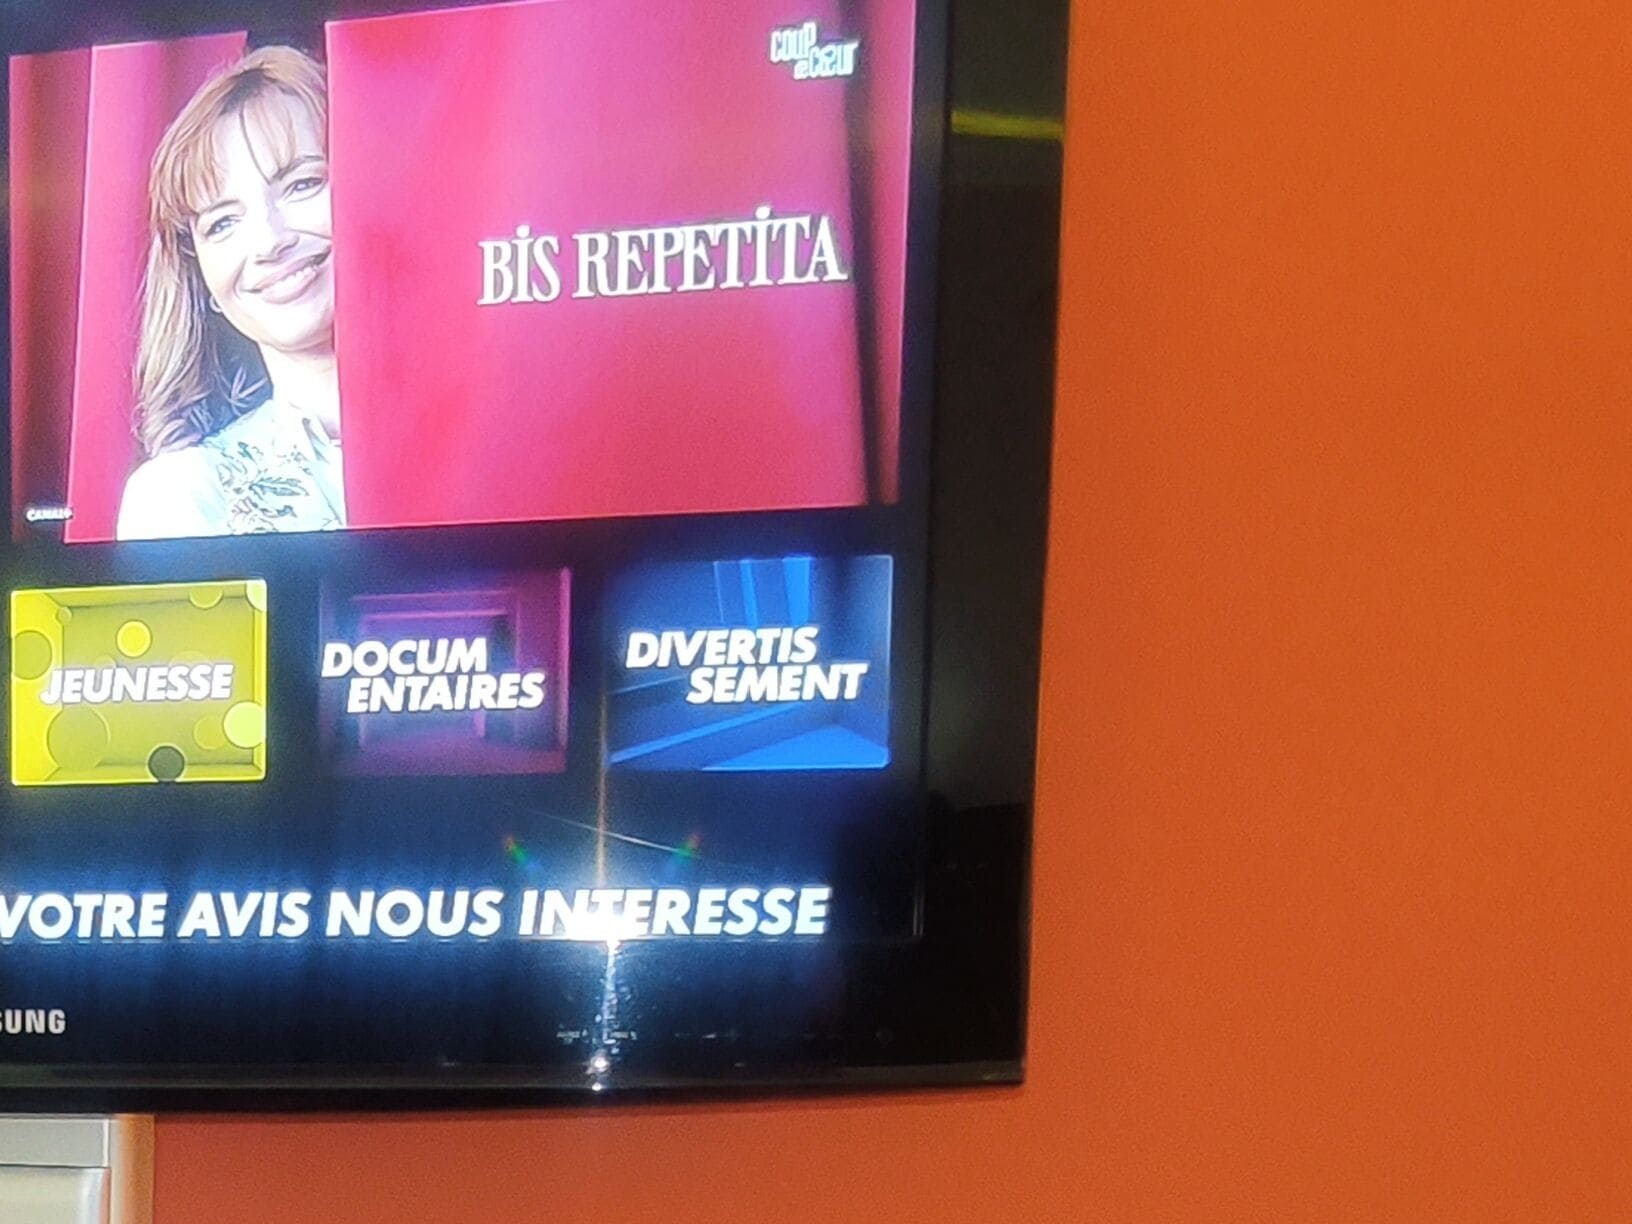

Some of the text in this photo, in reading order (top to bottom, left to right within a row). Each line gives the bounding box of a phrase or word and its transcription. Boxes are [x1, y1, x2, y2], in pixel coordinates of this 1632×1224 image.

[320, 637, 488, 679] DOCUM
[624, 626, 818, 670] DIVERTIS
[39, 663, 235, 705] JEUNESSE
[346, 672, 546, 714] ENTAIRES
[684, 663, 869, 705] SEMENT
[176, 890, 313, 939] AVIS
[325, 888, 506, 938] NOUS
[517, 886, 833, 938] INTERESSE
